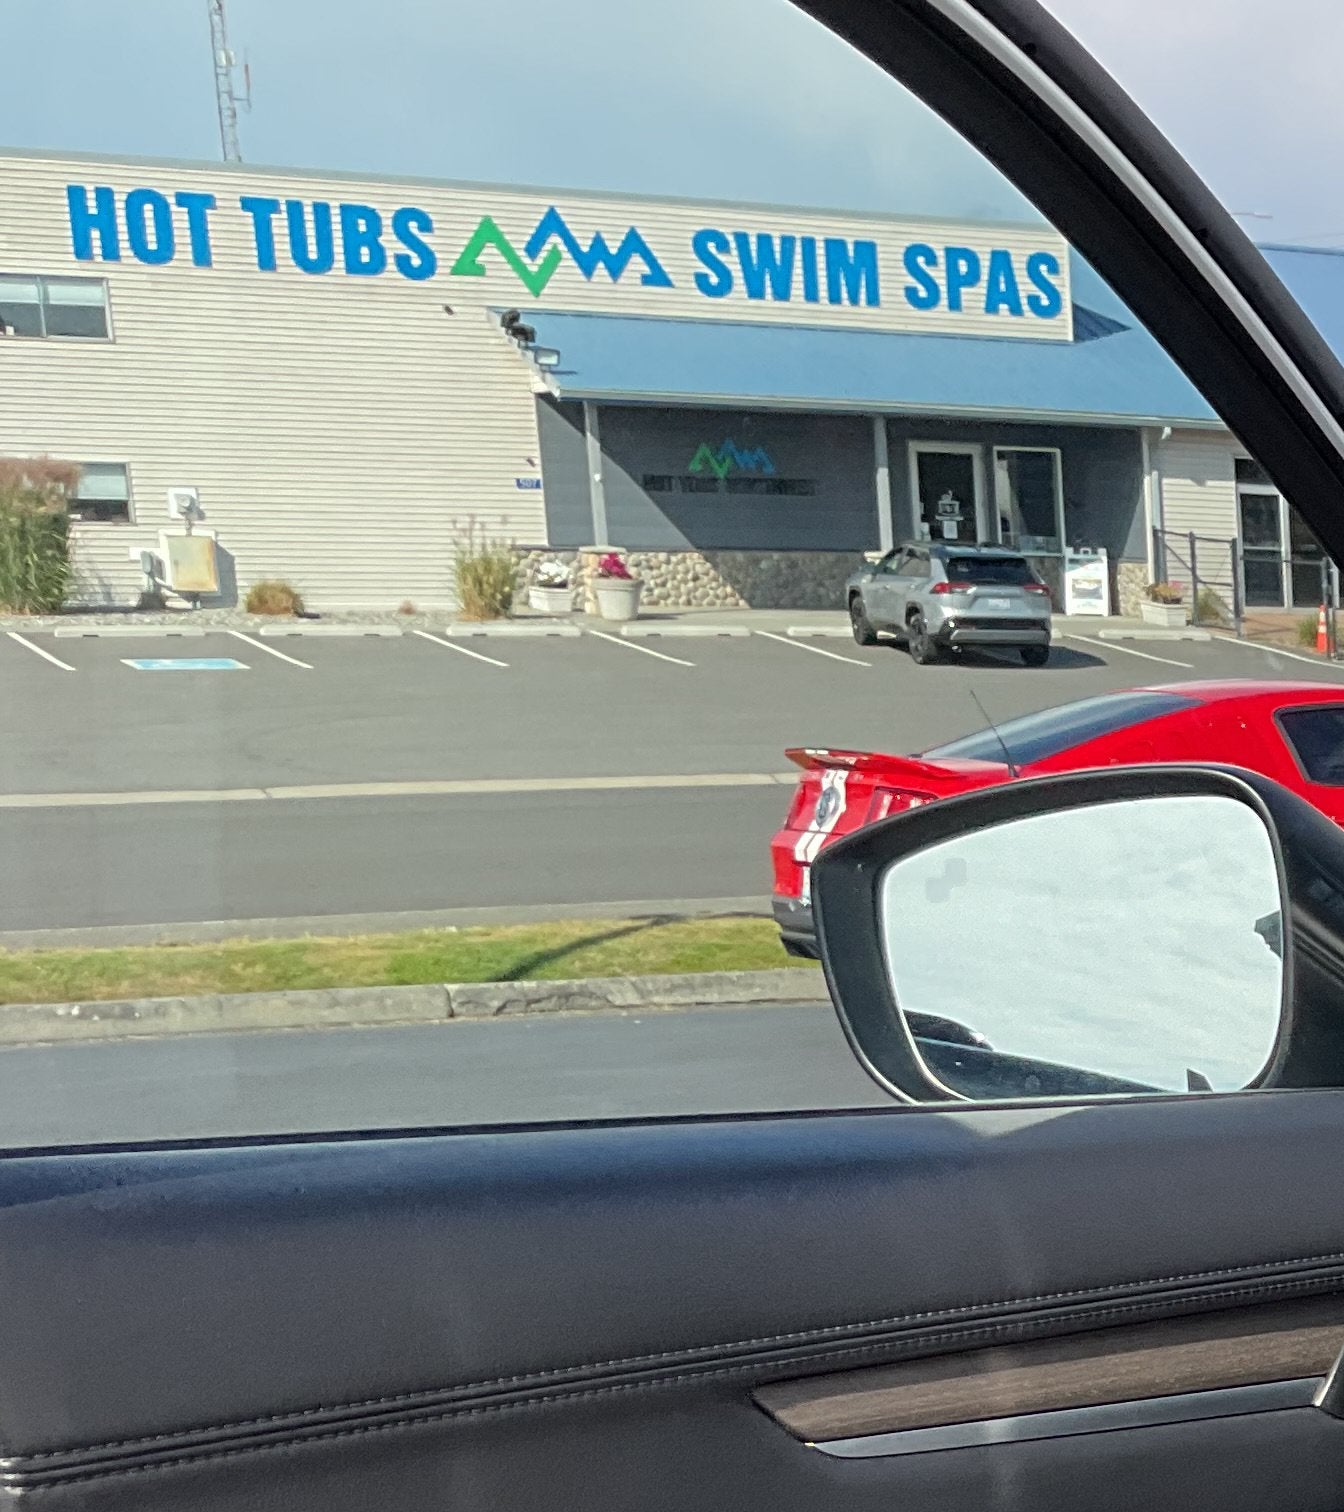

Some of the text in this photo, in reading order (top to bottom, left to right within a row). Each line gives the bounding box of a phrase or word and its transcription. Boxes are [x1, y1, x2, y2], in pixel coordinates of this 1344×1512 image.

[67, 184, 438, 281] HOT TUBS
[692, 228, 1063, 319] SWIM SPAS
